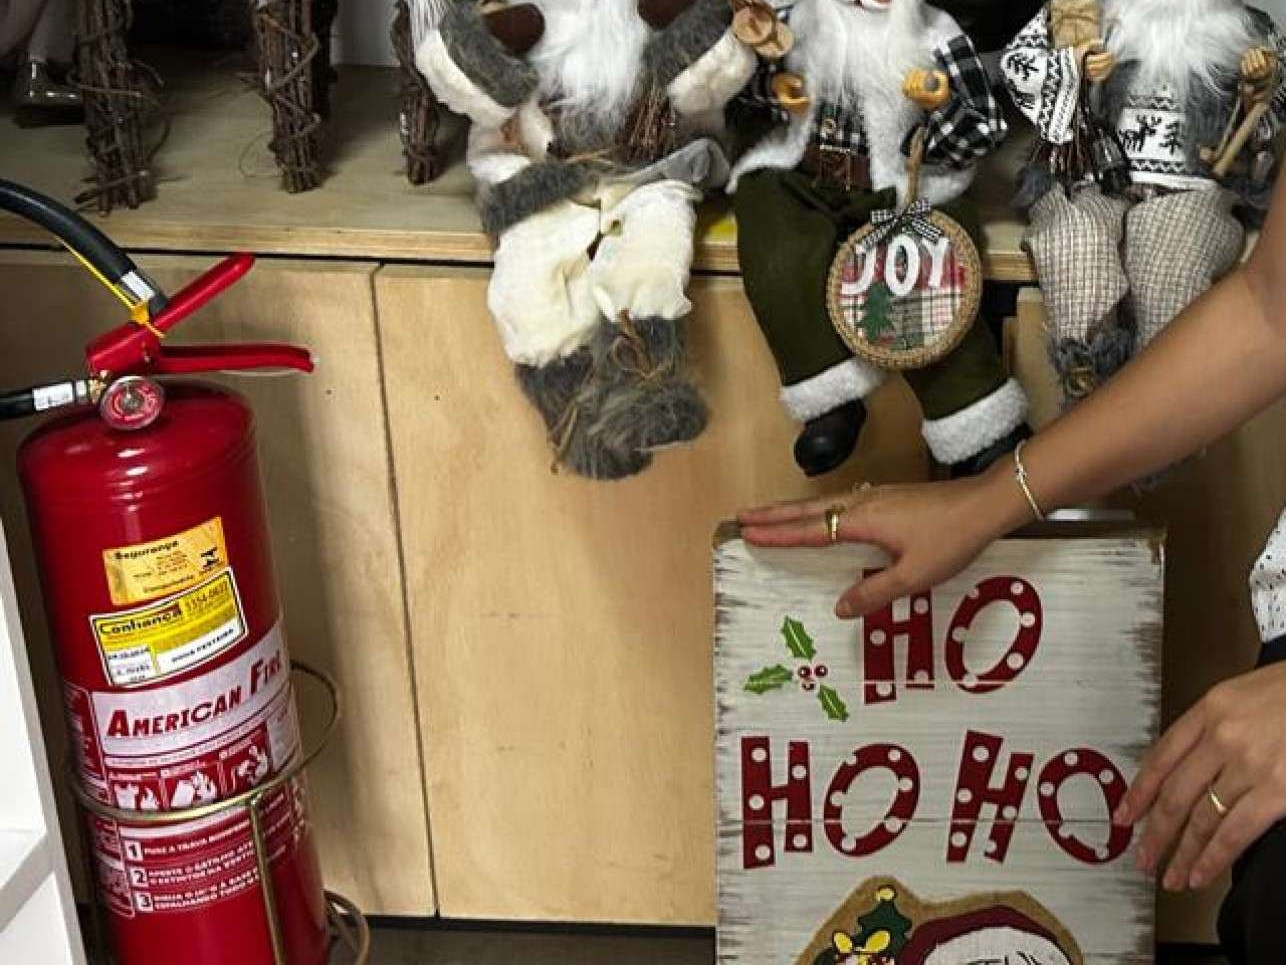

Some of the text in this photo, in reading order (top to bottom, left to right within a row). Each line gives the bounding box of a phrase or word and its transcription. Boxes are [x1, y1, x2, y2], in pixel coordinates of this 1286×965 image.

[841, 235, 951, 297] JOY
[862, 568, 1044, 705] HO
[108, 686, 242, 737] AMERICAN
[741, 730, 1135, 869] HO HO
